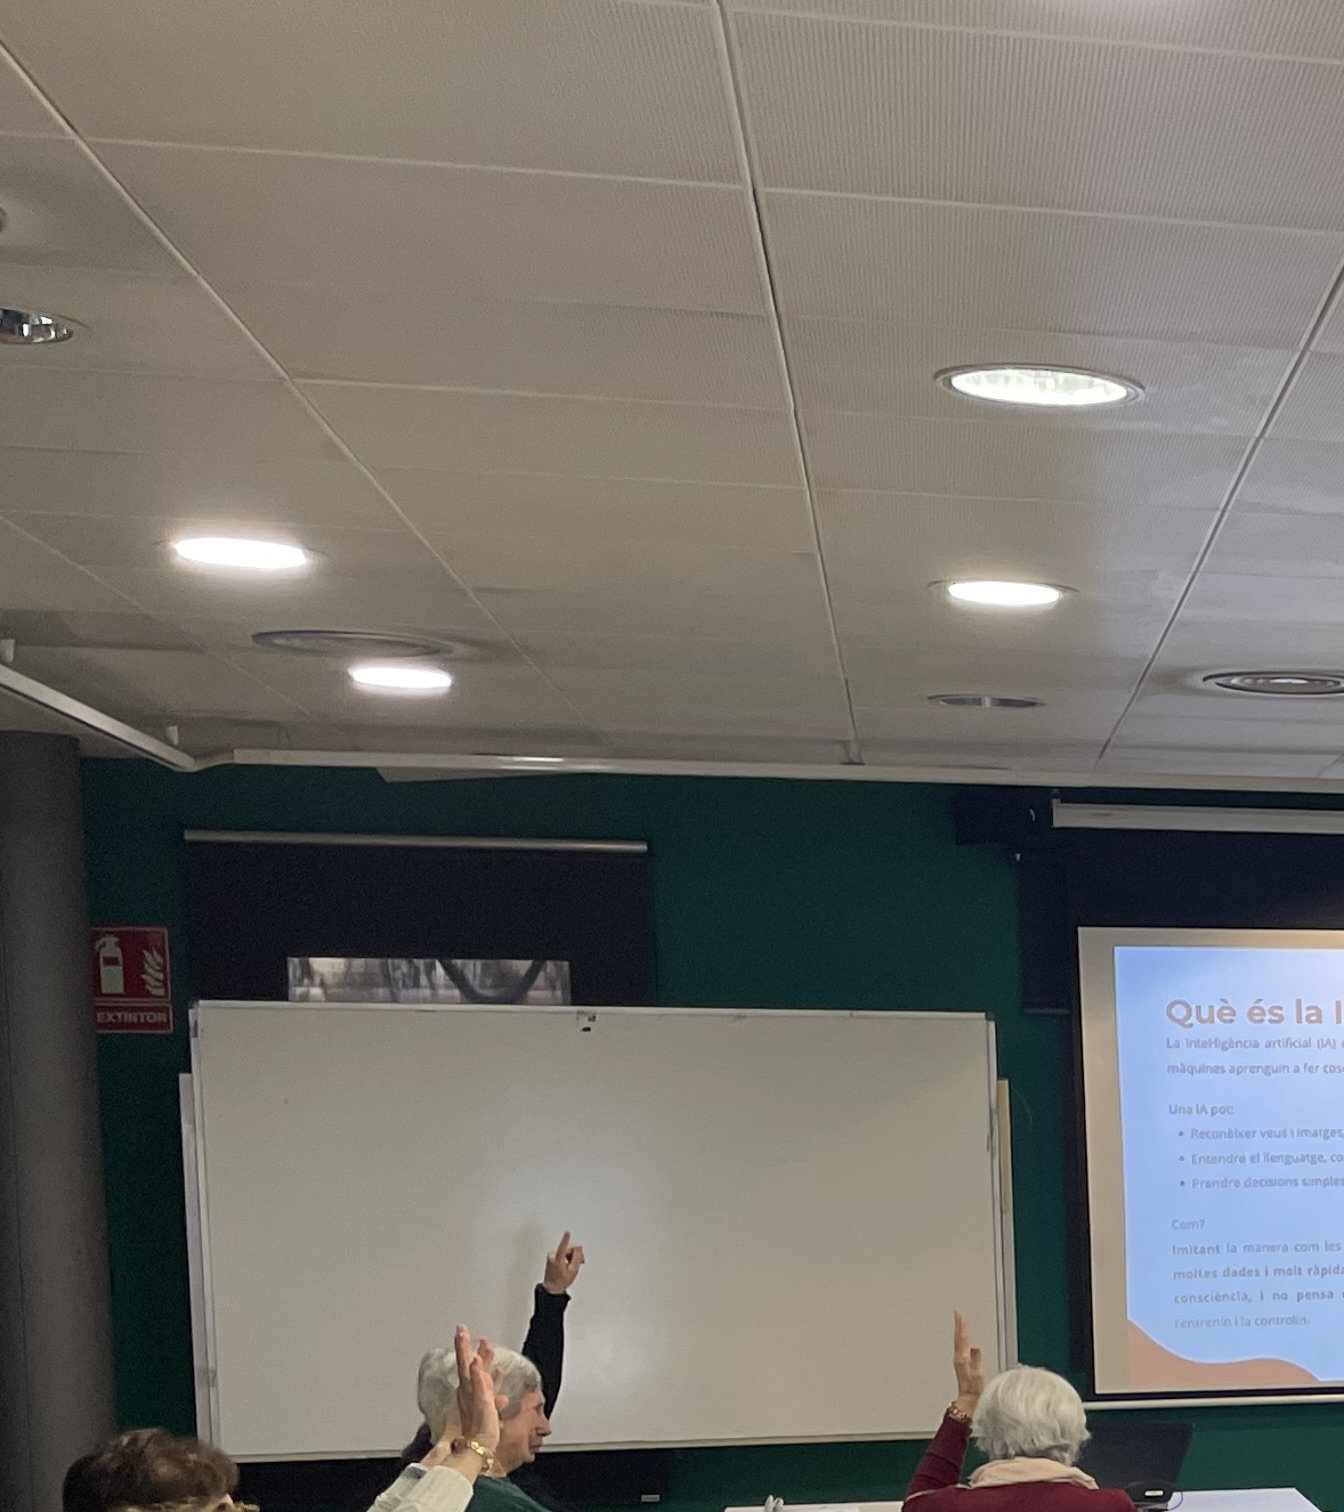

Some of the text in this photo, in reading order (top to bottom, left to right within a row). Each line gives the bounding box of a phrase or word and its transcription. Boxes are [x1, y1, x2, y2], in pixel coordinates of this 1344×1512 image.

[96, 1012, 167, 1023] EXTINTOR
[1166, 999, 1236, 1029] Què
[1247, 999, 1284, 1024] és
[1295, 999, 1322, 1024] la
[1166, 1039, 1180, 1048] La
[1265, 1038, 1311, 1048] artificial
[1317, 1039, 1336, 1050] (IA)
[1168, 1063, 1226, 1076] màquines
[1229, 1063, 1289, 1076] aprenguin
[1304, 1063, 1319, 1073] fer
[1169, 1104, 1234, 1117] Una IA pot:
[1260, 1130, 1287, 1139] veus
[1297, 1128, 1344, 1140] imatges,
[1192, 1153, 1246, 1164] Entendre
[1250, 1153, 1260, 1163] el
[1264, 1152, 1326, 1165] llenguatge,
[1192, 1178, 1240, 1188] Prendre
[1244, 1177, 1299, 1187] decisions
[1172, 1220, 1205, 1230] Com?
[1173, 1244, 1220, 1255] Imitant
[1226, 1244, 1237, 1253] la
[1243, 1244, 1288, 1253] manera
[1295, 1242, 1319, 1252] com
[1324, 1241, 1341, 1252] les
[1174, 1268, 1217, 1280] moltes
[1223, 1267, 1260, 1278] dades
[1274, 1266, 1302, 1277] molt
[1175, 1291, 1251, 1303] consciència,
[1273, 1293, 1288, 1301] no
[1297, 1290, 1333, 1302] pensa
[1241, 1316, 1251, 1327] la
[1255, 1315, 1310, 1327] controlin.
